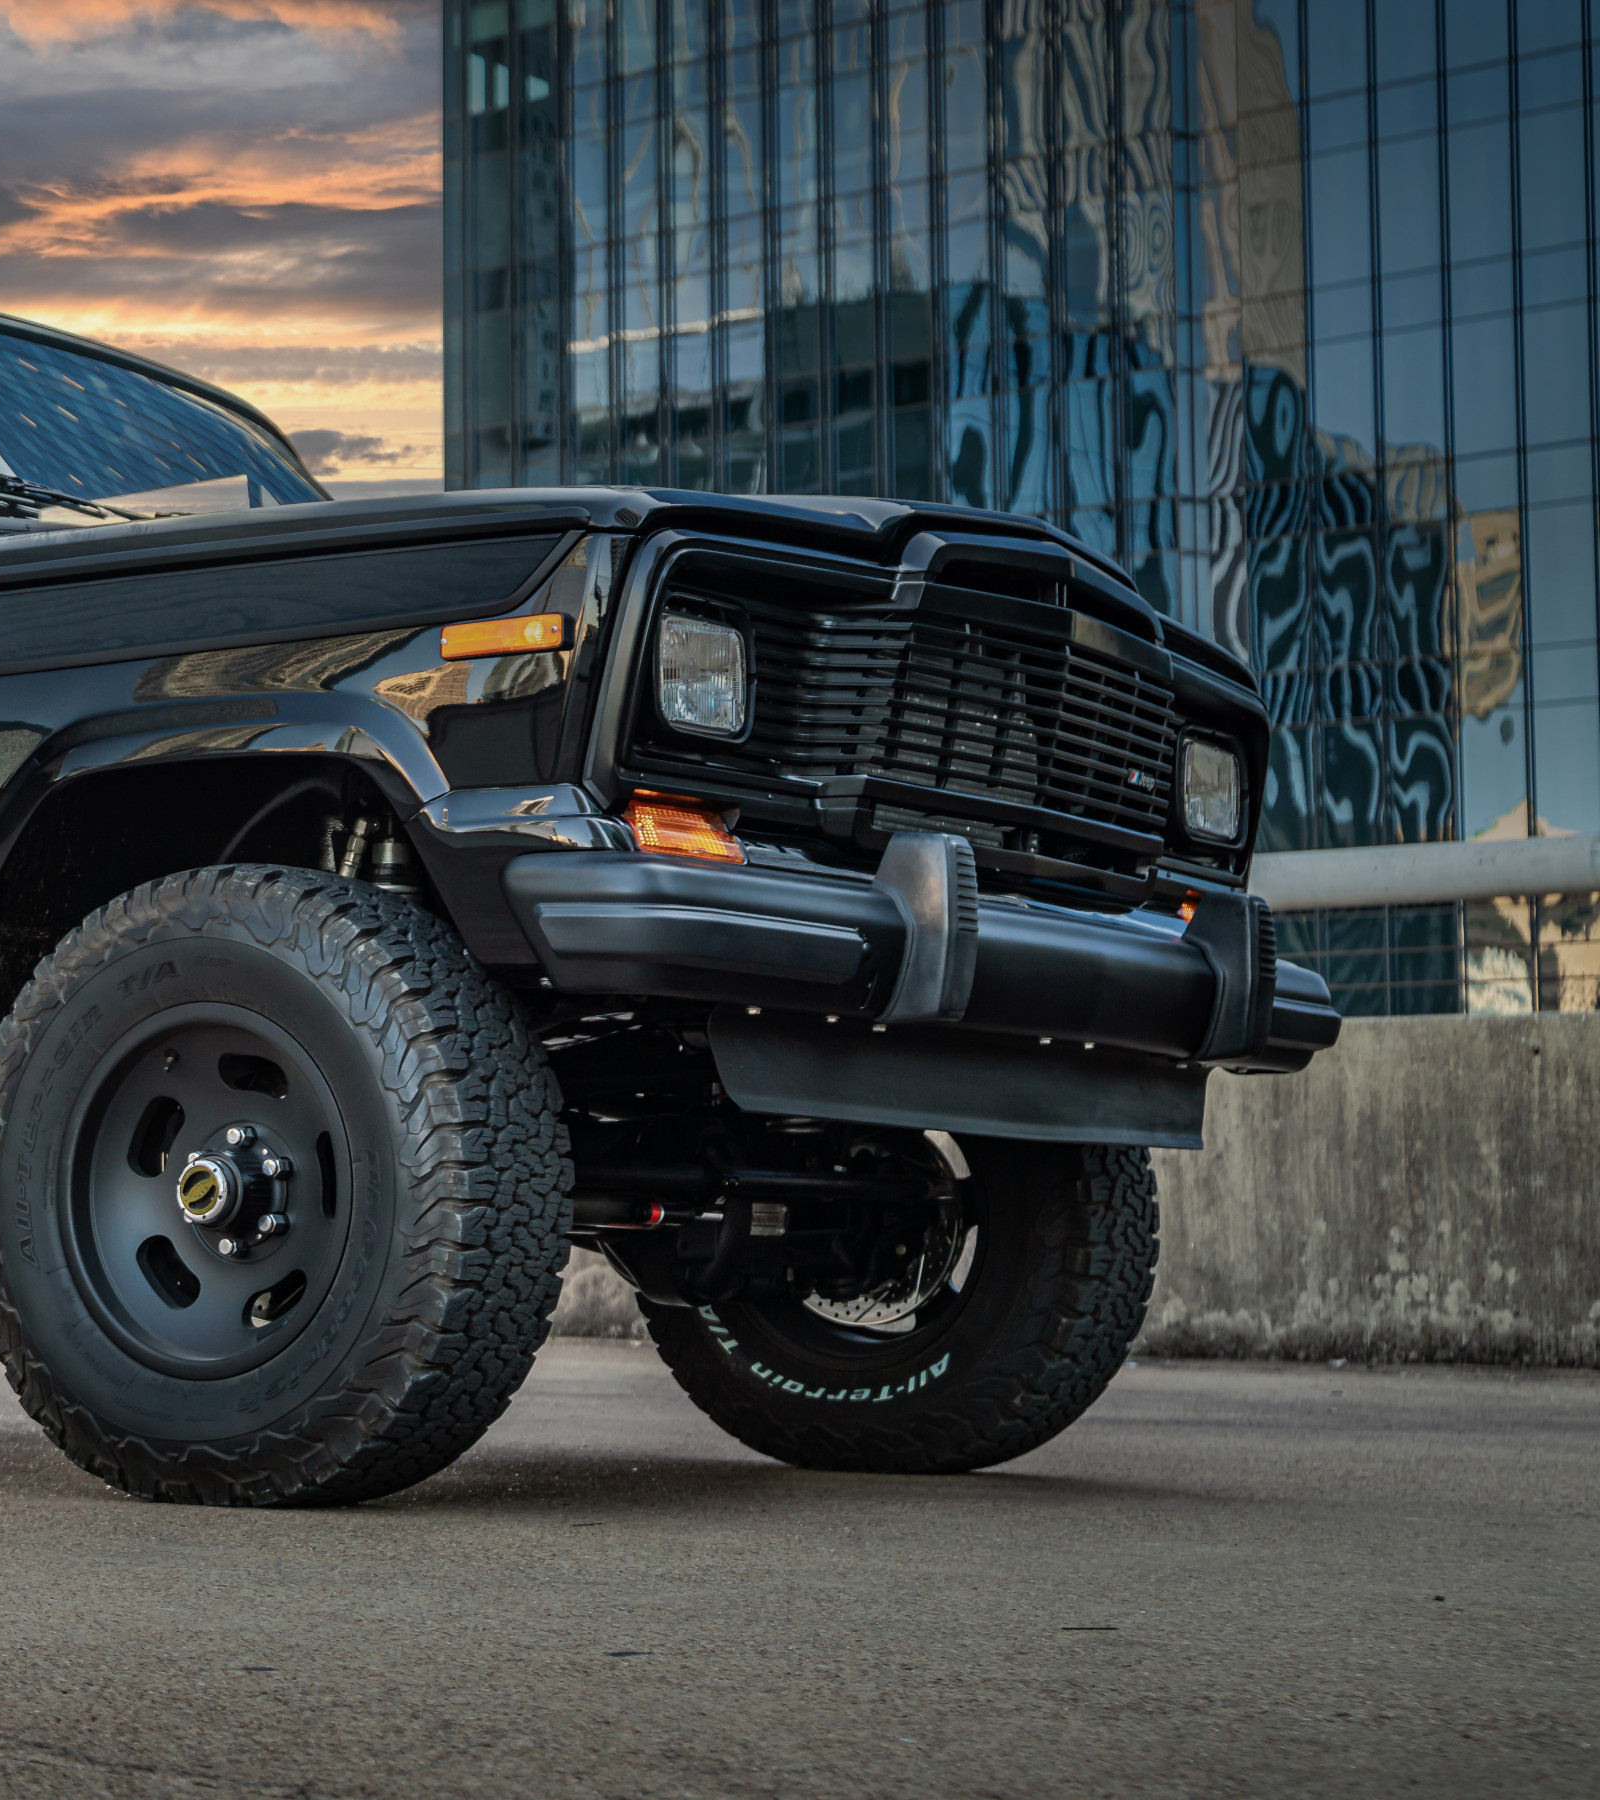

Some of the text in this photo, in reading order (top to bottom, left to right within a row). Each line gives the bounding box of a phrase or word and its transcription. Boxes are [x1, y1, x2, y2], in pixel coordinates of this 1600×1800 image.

[1138, 772, 1155, 792] Jeep
[15, 1003, 104, 1269] All-Terrain
[116, 960, 180, 999] T/A
[698, 1304, 950, 1403] All-Terrain T/A
